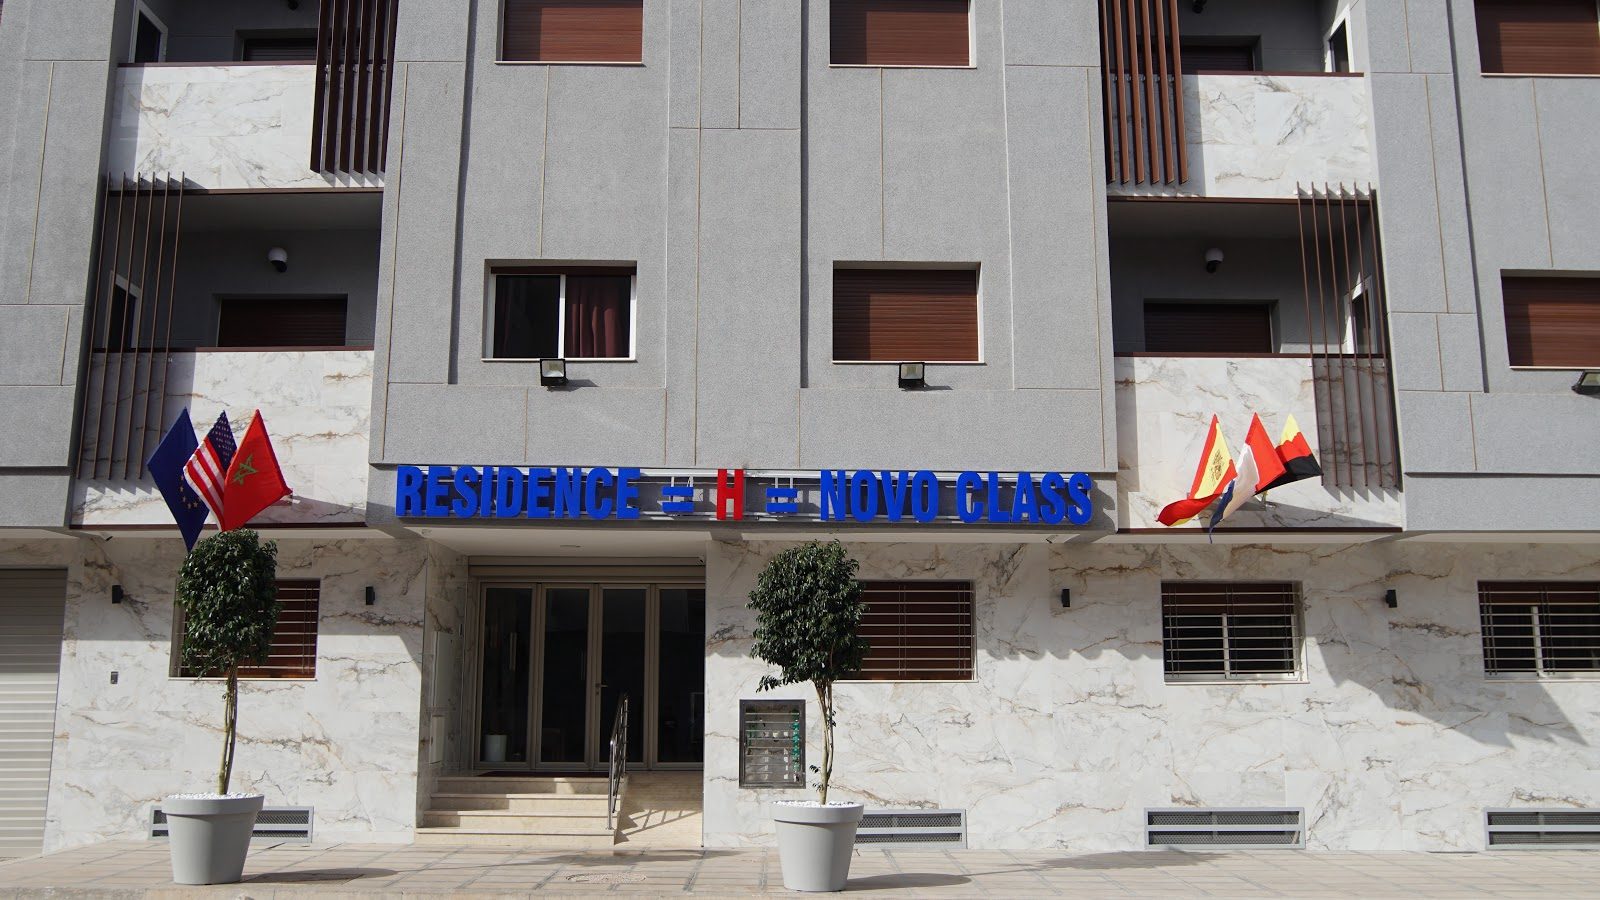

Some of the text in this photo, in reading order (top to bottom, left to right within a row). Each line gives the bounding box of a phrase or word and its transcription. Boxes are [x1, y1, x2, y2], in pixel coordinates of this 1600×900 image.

[396, 465, 640, 519] RESIDENCE
[716, 468, 744, 520] H
[820, 469, 939, 523] NOVO
[956, 471, 1092, 525] CLASS
